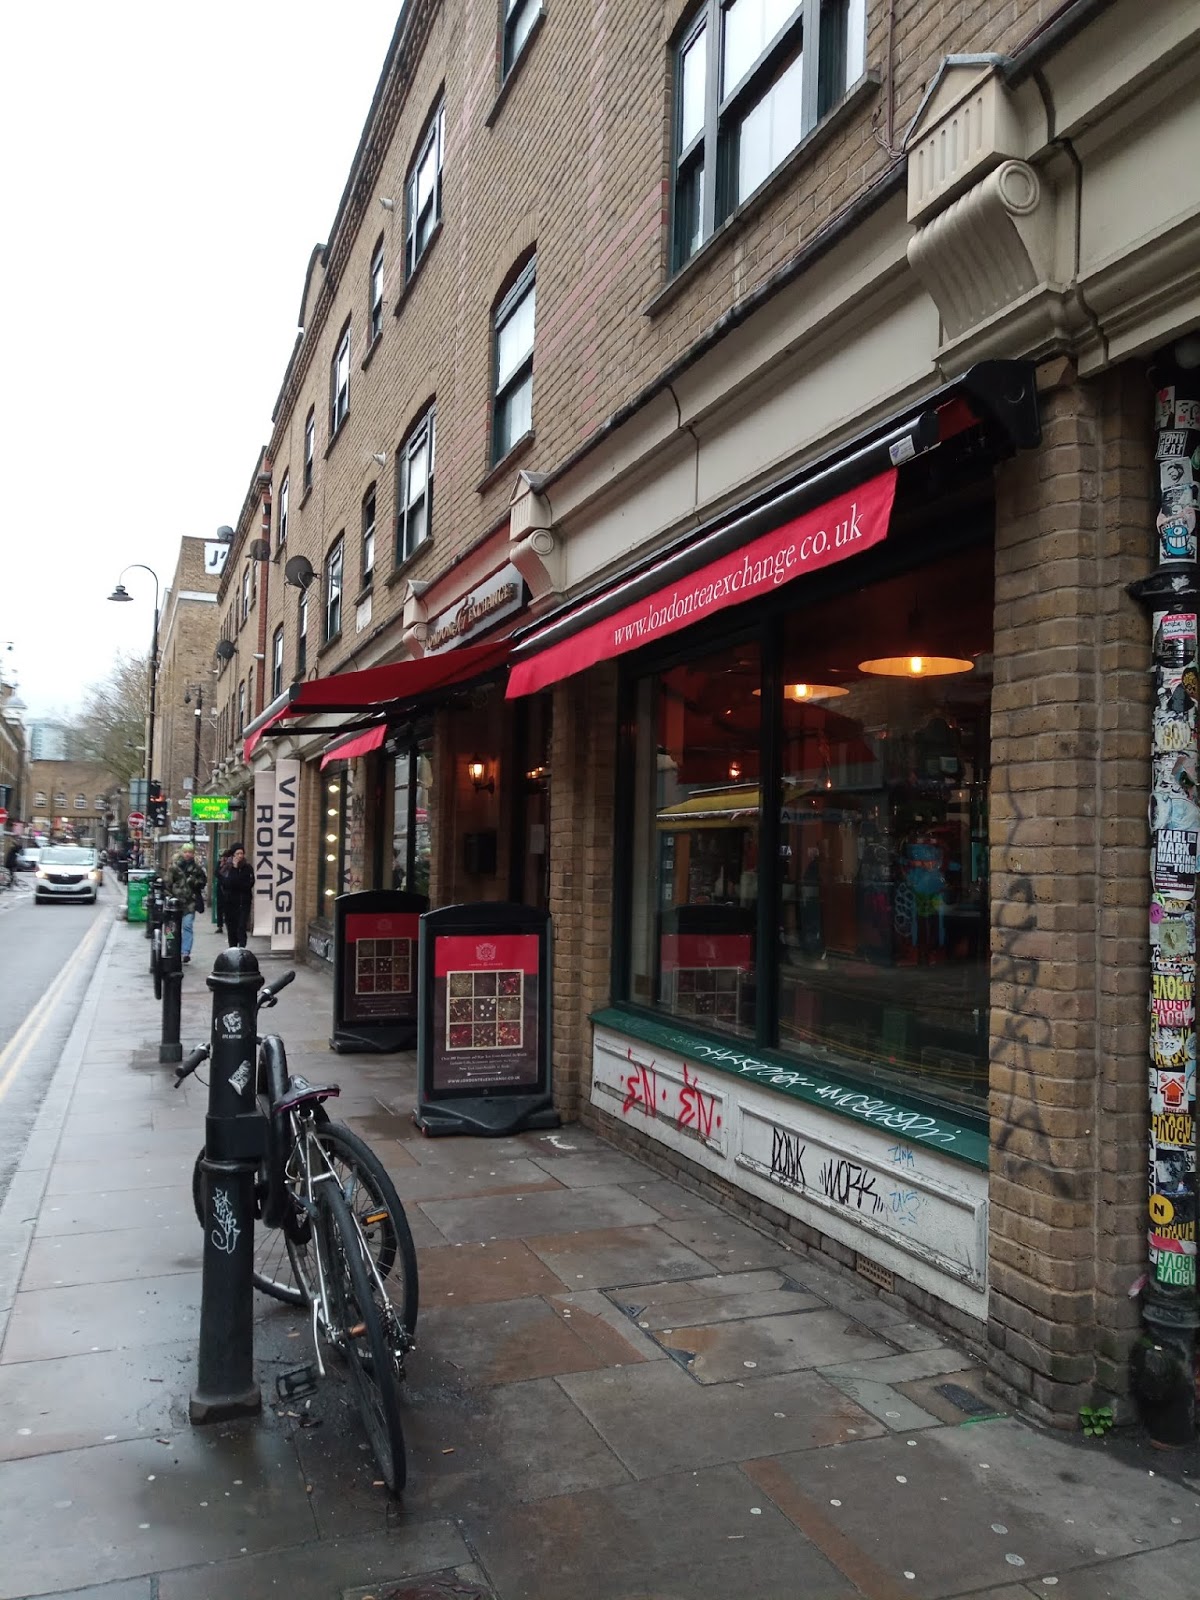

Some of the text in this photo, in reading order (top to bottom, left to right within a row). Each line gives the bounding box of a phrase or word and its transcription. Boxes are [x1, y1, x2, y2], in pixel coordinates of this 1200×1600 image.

[613, 503, 864, 646] www.londonteaexchange.co.uk
[1158, 830, 1187, 843] KARL
[256, 805, 274, 900] ROKIT
[275, 776, 296, 935] VINTAGE
[1157, 853, 1196, 865] WALKING
[1173, 864, 1195, 874] TOUR
[1158, 1010, 1191, 1027] ABOV
